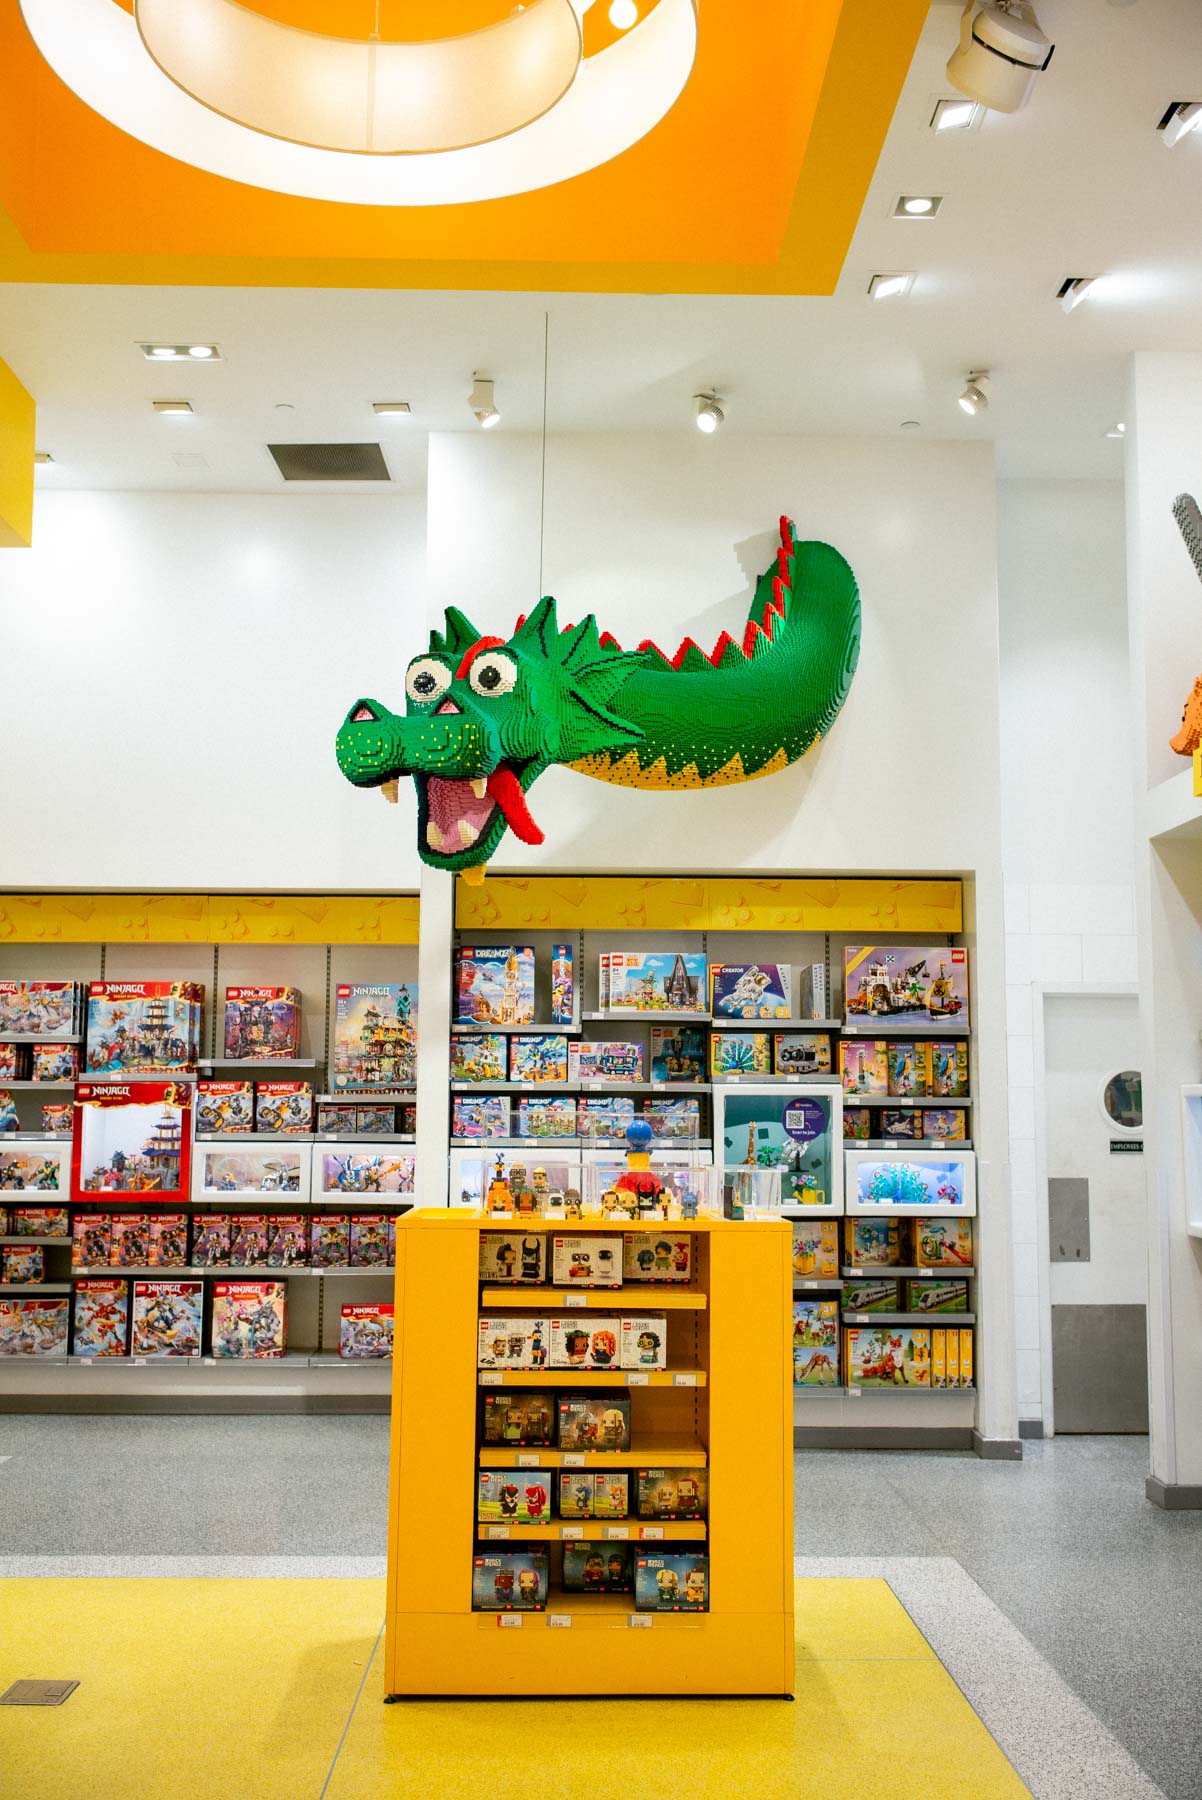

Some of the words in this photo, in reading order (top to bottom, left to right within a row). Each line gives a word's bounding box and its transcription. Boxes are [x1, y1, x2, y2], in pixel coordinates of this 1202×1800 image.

[104, 984, 147, 995] NINJAGO
[352, 987, 390, 997] NINJAGO
[92, 1086, 132, 1096] NINJAGO
[228, 1285, 262, 1295] NINJAGO
